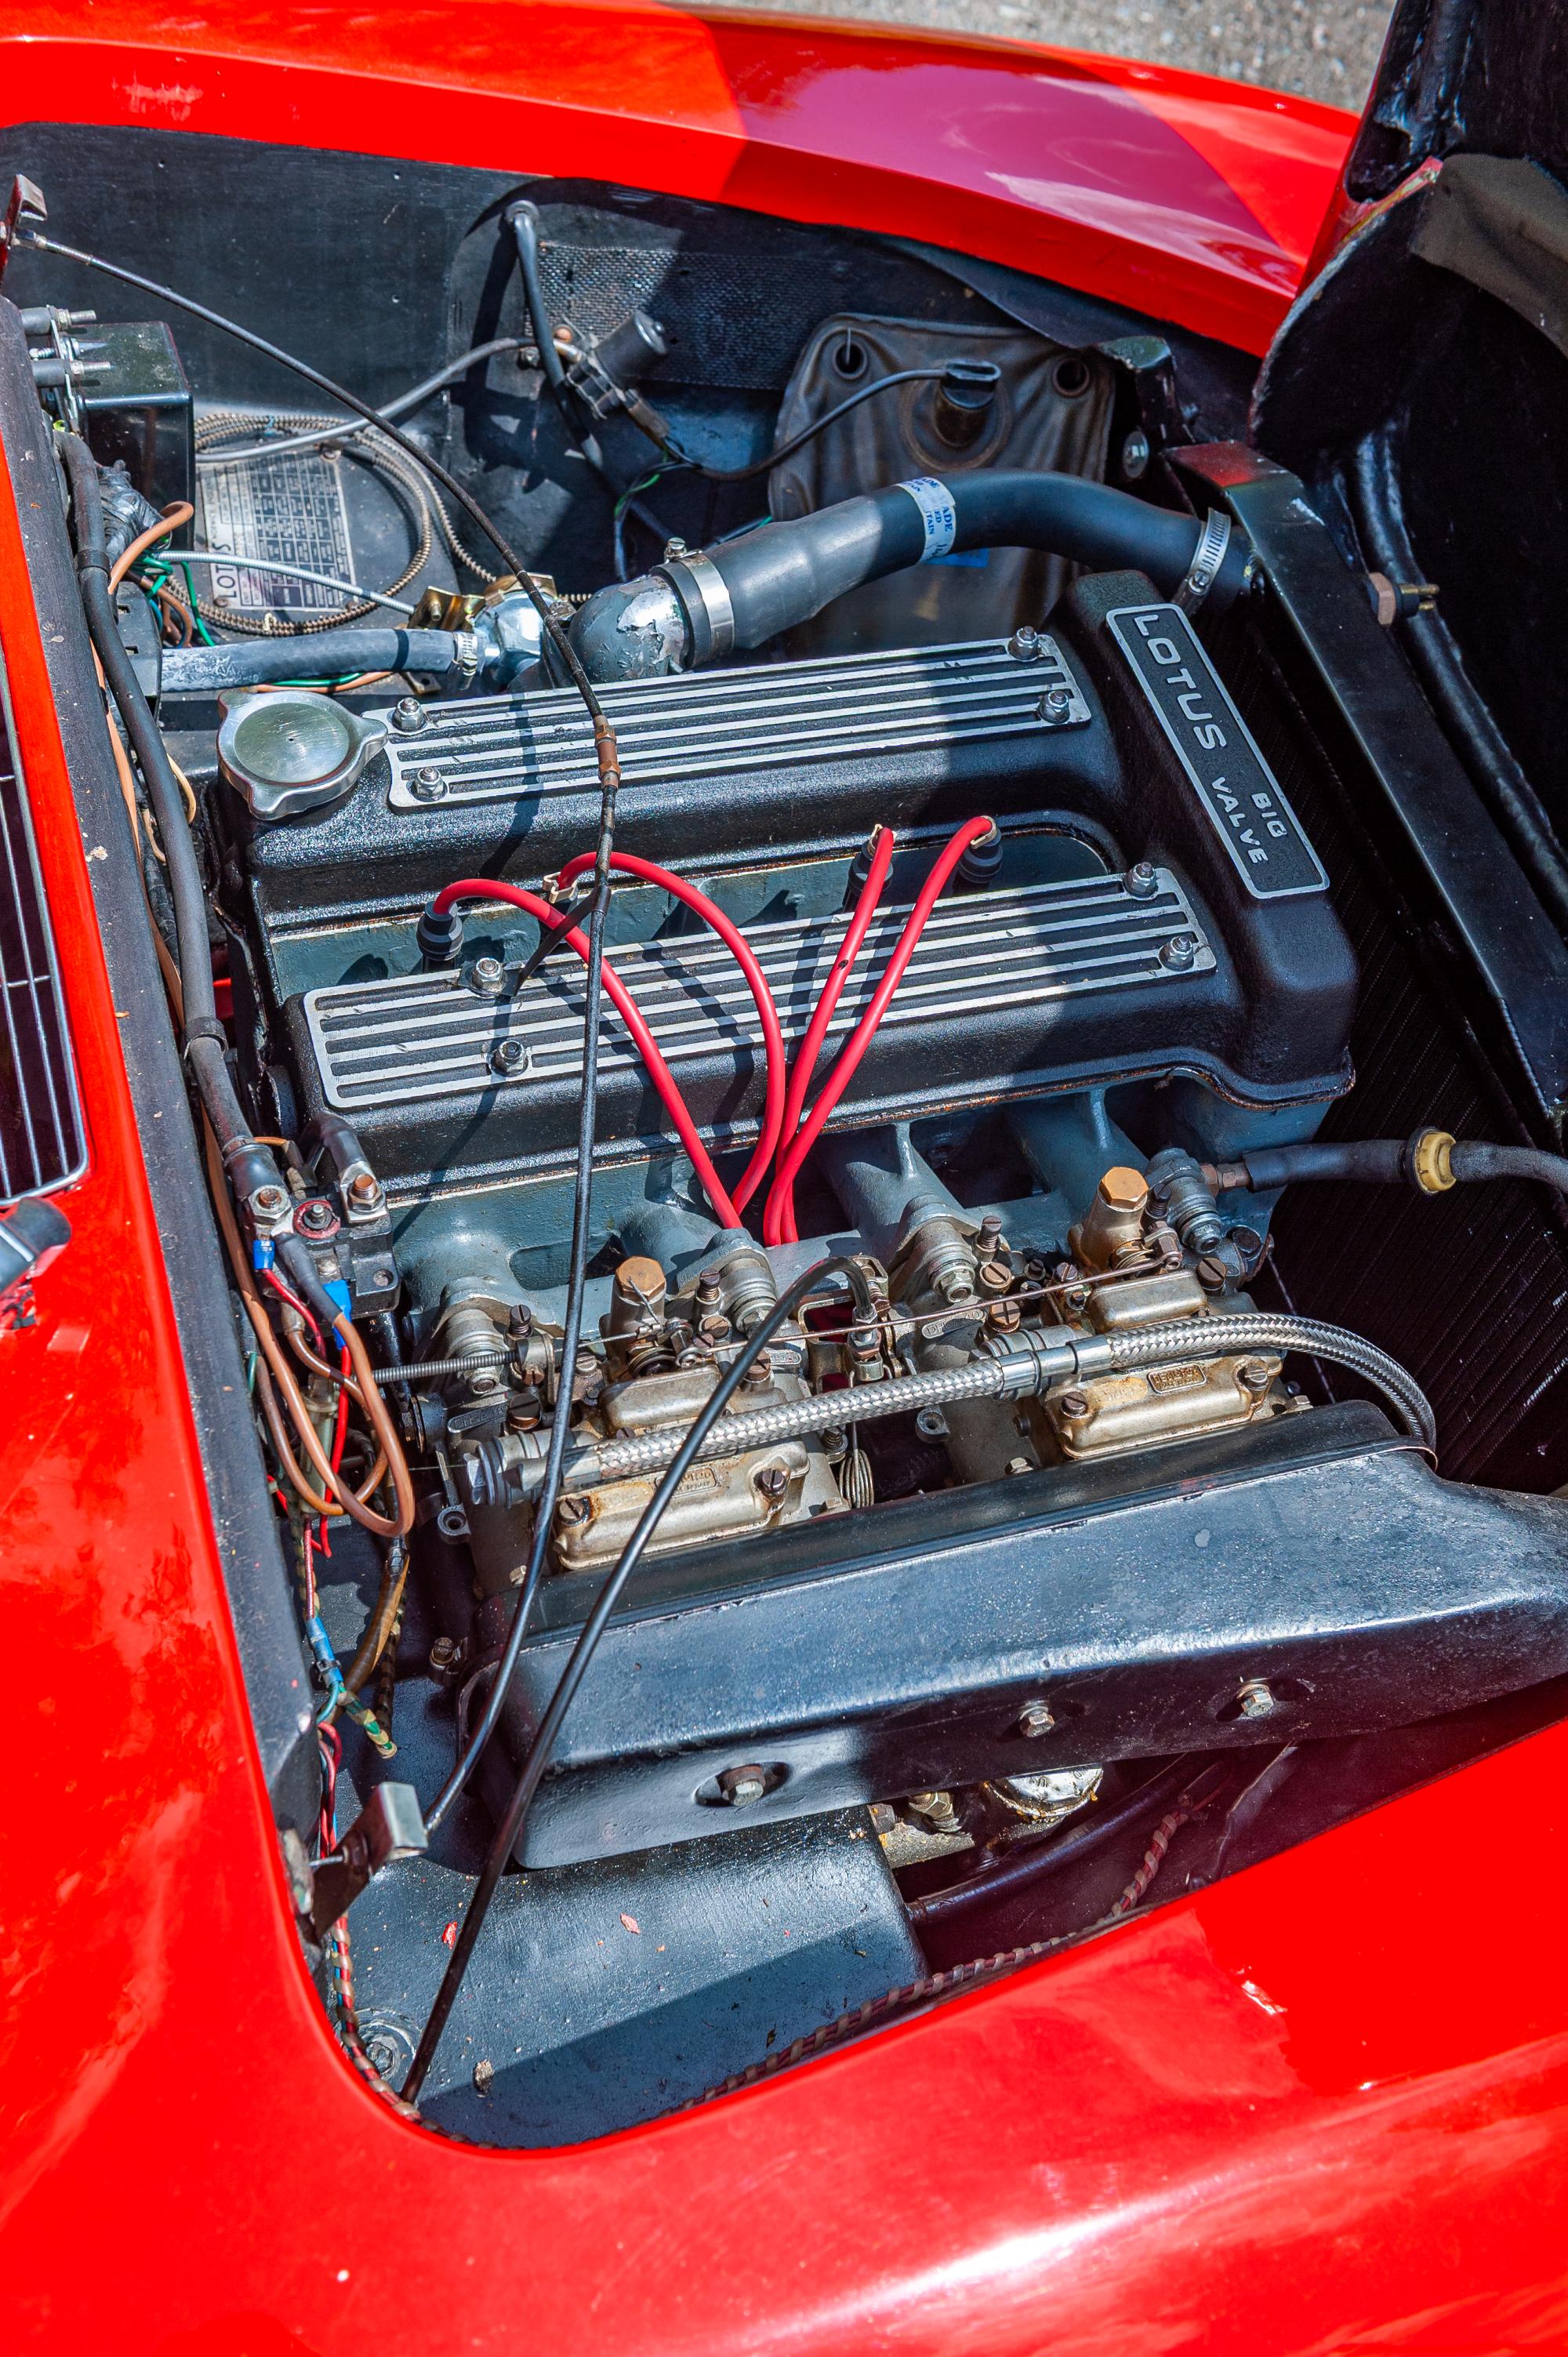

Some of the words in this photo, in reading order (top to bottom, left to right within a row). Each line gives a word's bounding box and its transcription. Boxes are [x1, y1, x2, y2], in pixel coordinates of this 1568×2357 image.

[212, 542, 237, 598] LOTS
[1134, 614, 1227, 750] LOTUS
[1211, 776, 1269, 864] VALVE
[1251, 792, 1287, 837] BIG
